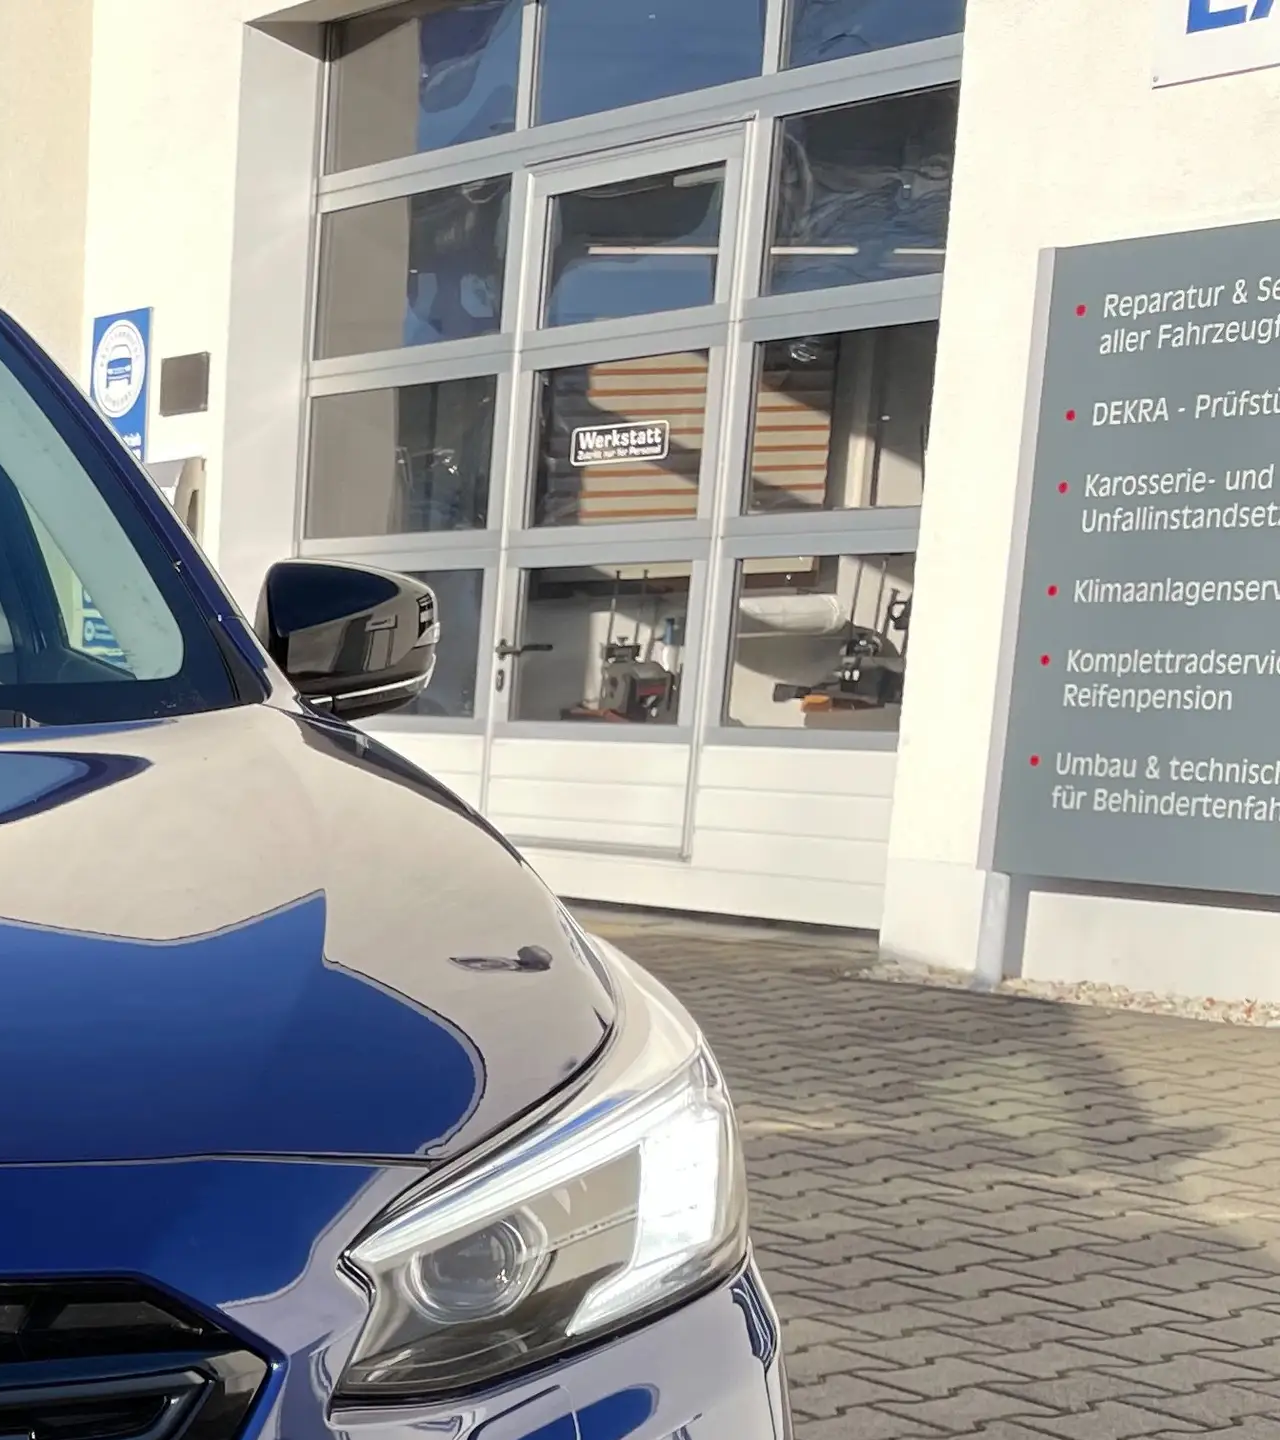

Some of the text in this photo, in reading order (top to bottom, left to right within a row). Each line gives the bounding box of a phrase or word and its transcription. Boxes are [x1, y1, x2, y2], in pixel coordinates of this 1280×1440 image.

[1103, 284, 1224, 319] Reparatur
[1232, 279, 1248, 305] &
[1099, 329, 1150, 355] aller
[1092, 397, 1168, 426] DEKRA
[578, 427, 662, 450] Werkstatt
[1084, 464, 1274, 498] Karosserie- und
[1062, 683, 1233, 713] Reifenpension
[1055, 752, 1137, 778] Umbau
[1145, 755, 1160, 780] &
[1051, 785, 1087, 810] für
